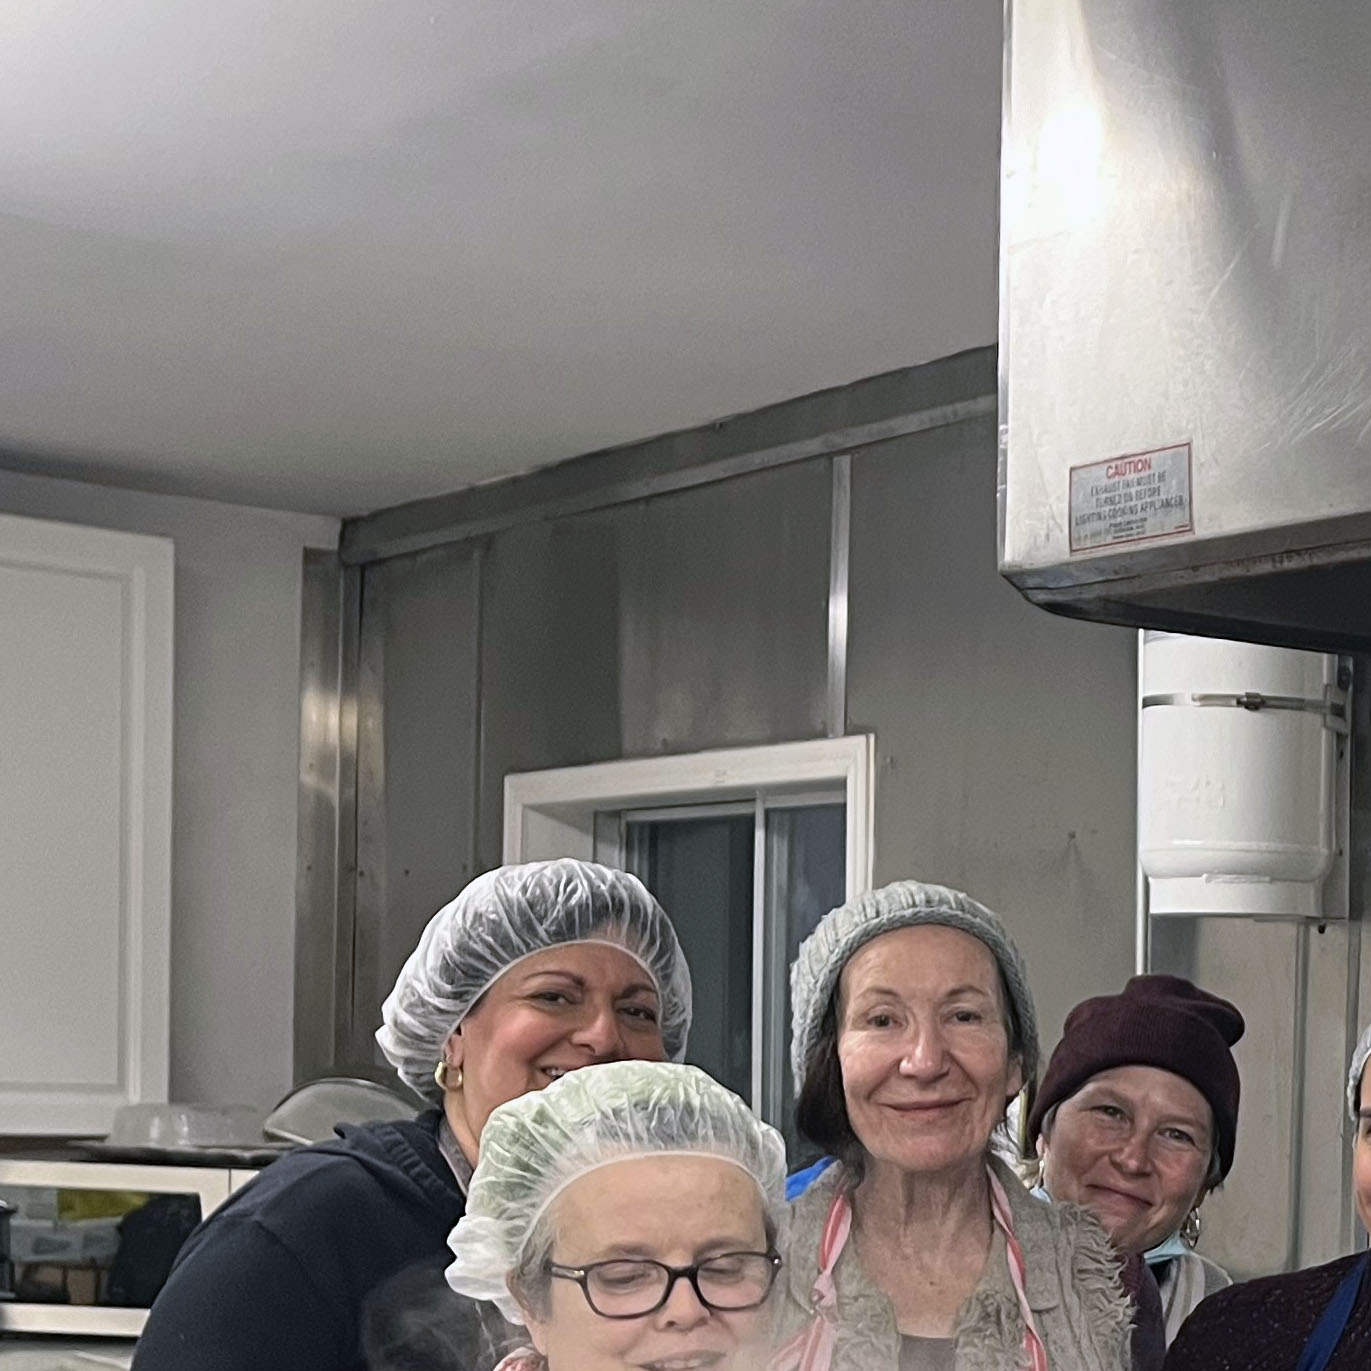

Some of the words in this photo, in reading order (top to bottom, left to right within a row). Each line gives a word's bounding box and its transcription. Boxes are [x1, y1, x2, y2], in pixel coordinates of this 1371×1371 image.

[1106, 457, 1152, 480] CAUTION
[1135, 486, 1161, 501] BEFORE
[1108, 502, 1138, 520] COOKING
